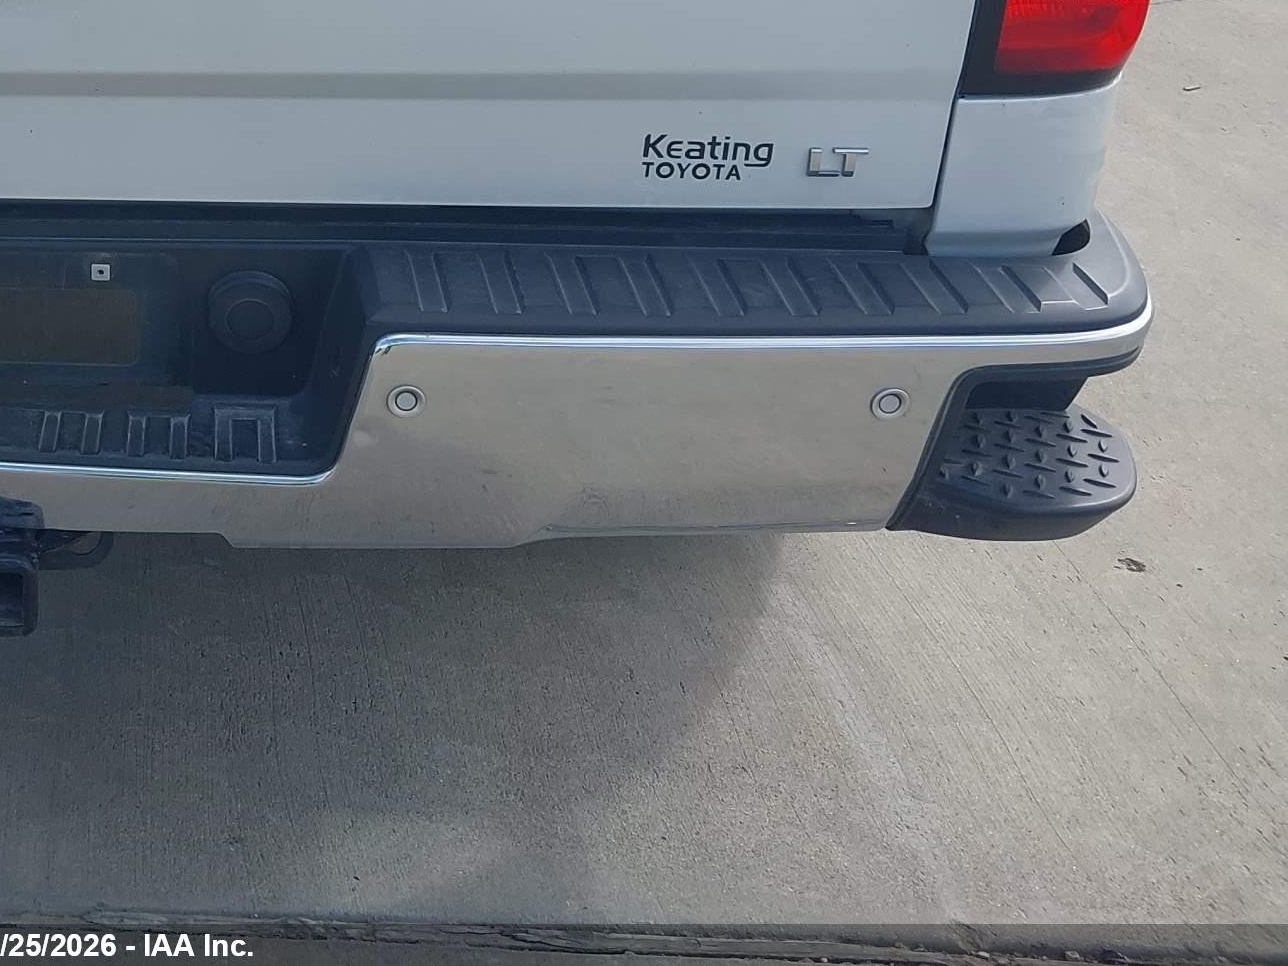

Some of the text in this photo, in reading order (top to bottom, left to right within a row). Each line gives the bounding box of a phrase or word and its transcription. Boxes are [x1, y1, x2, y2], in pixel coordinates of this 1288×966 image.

[642, 133, 774, 167] Keating
[806, 147, 870, 177] LT
[641, 161, 741, 180] TOYOTA
